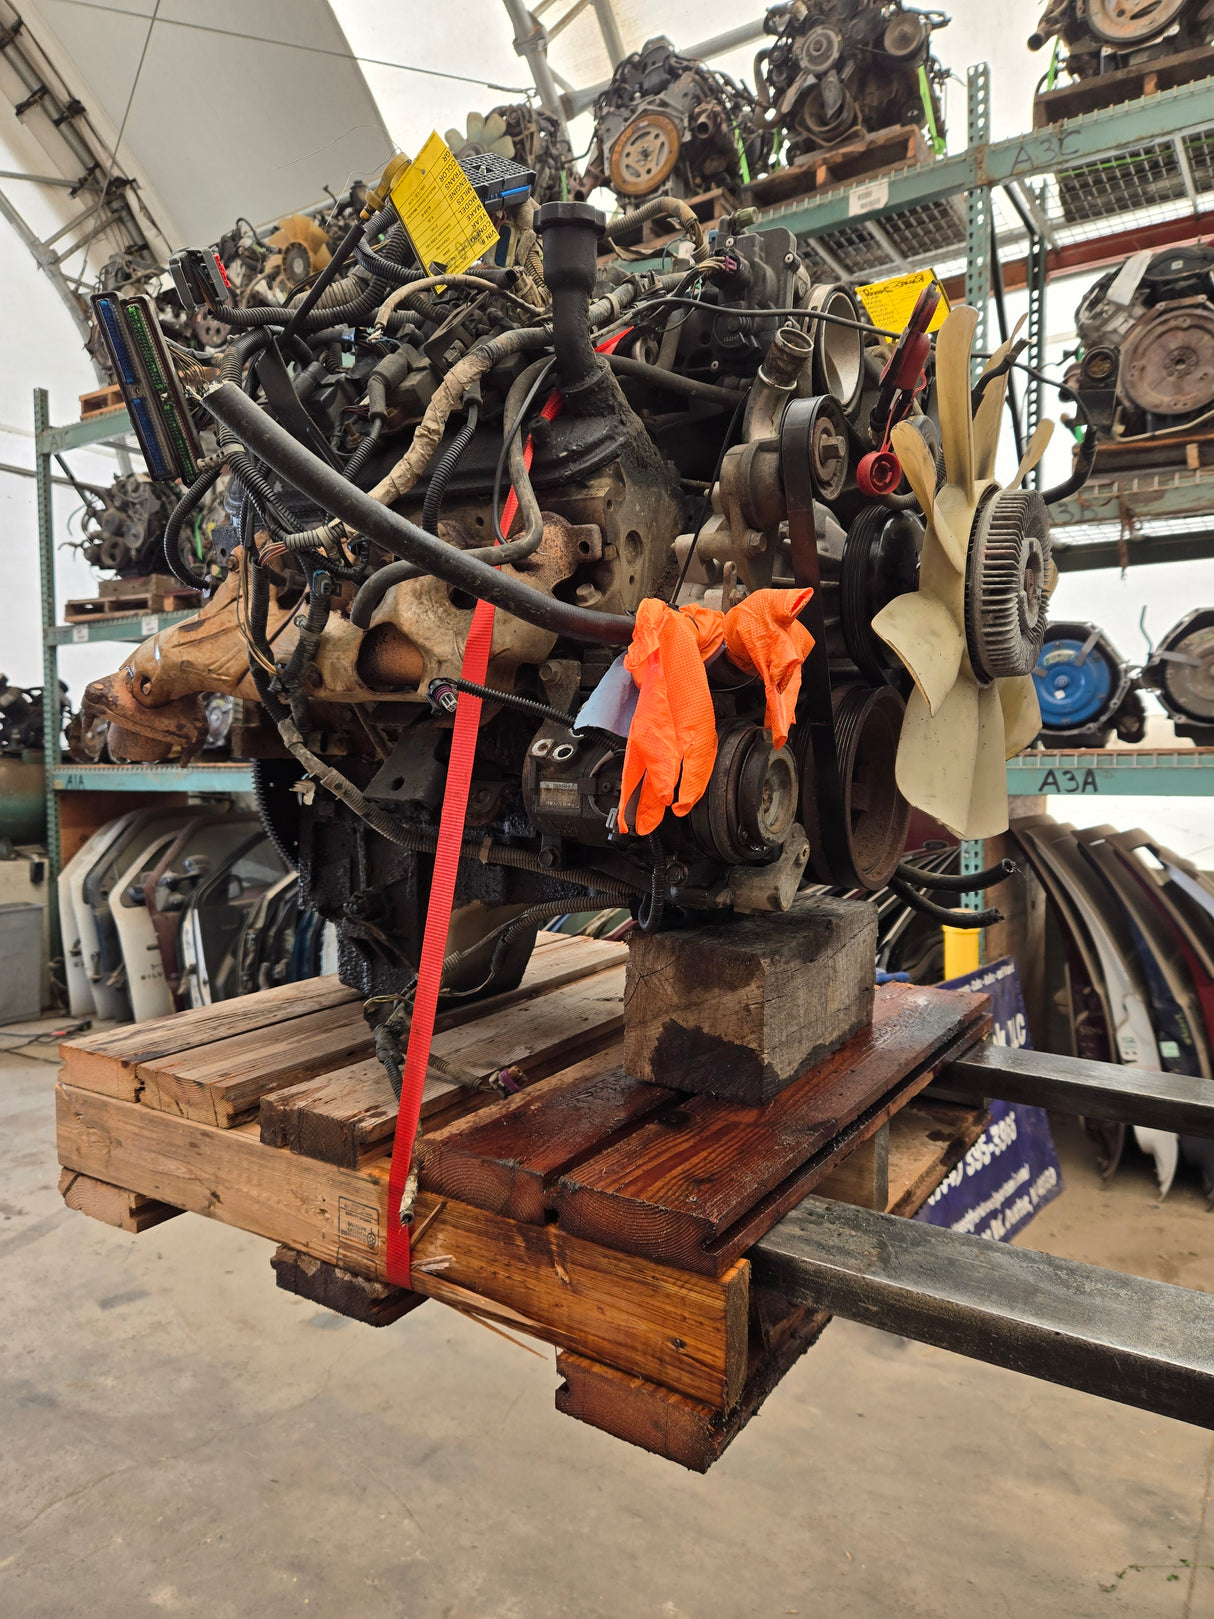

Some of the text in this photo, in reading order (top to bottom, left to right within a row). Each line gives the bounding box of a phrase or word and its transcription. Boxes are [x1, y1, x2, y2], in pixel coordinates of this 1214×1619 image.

[442, 150, 451, 162] GR
[1010, 130, 1082, 175] A3C
[439, 159, 456, 183] COLOR
[445, 169, 462, 191] TRANS
[449, 178, 468, 201] ENGINE
[456, 187, 473, 206] MILES
[459, 195, 478, 215] MODEL
[466, 204, 482, 222] MAKE
[470, 220, 491, 243] CONFIG
[471, 213, 487, 230] YEAR
[486, 229, 497, 242] VIN
[1038, 768, 1098, 793] A3A
